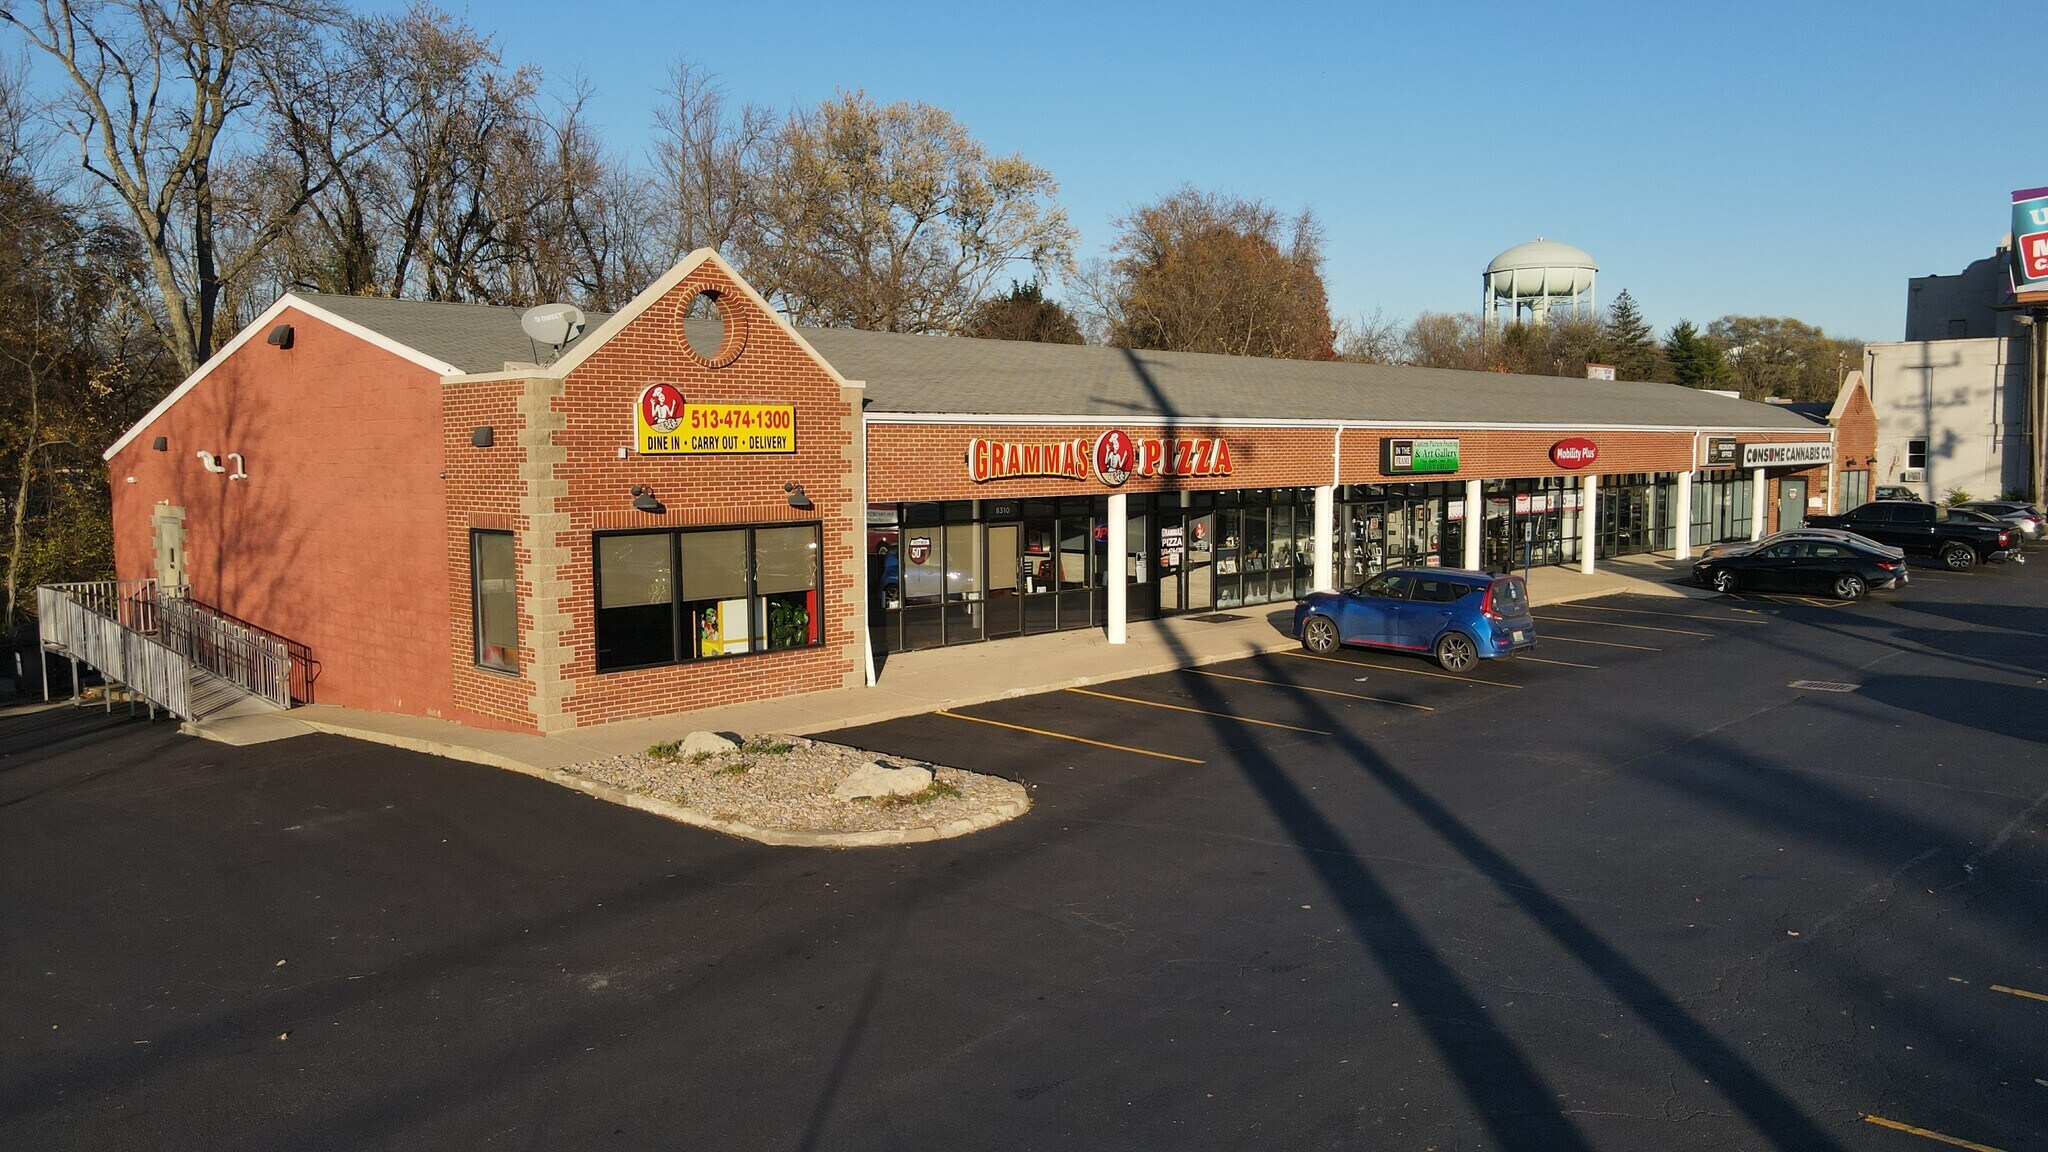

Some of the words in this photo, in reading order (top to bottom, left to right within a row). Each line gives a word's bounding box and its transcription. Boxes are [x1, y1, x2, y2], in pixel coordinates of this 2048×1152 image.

[647, 436, 668, 450] DINE
[671, 436, 680, 449] IN
[691, 436, 719, 450] CARRY
[722, 436, 738, 449] OUT
[749, 435, 787, 449] DELIVERY
[1395, 447, 1401, 455] IN
[1402, 447, 1411, 455] THE
[1415, 449, 1421, 458] &
[1423, 449, 1433, 458] Art
[1435, 448, 1457, 459] Gallery
[1557, 447, 1581, 461] Mobility
[1582, 446, 1595, 458] Plus
[1746, 447, 1785, 463] CONSUME
[1786, 446, 1820, 461] CANNABIS
[970, 437, 1090, 482] GRAMMAS
[1137, 437, 1233, 477] PIZZA
[995, 506, 1011, 515] 8310
[1161, 537, 1183, 547] PIZZA
[911, 547, 921, 559] 50
